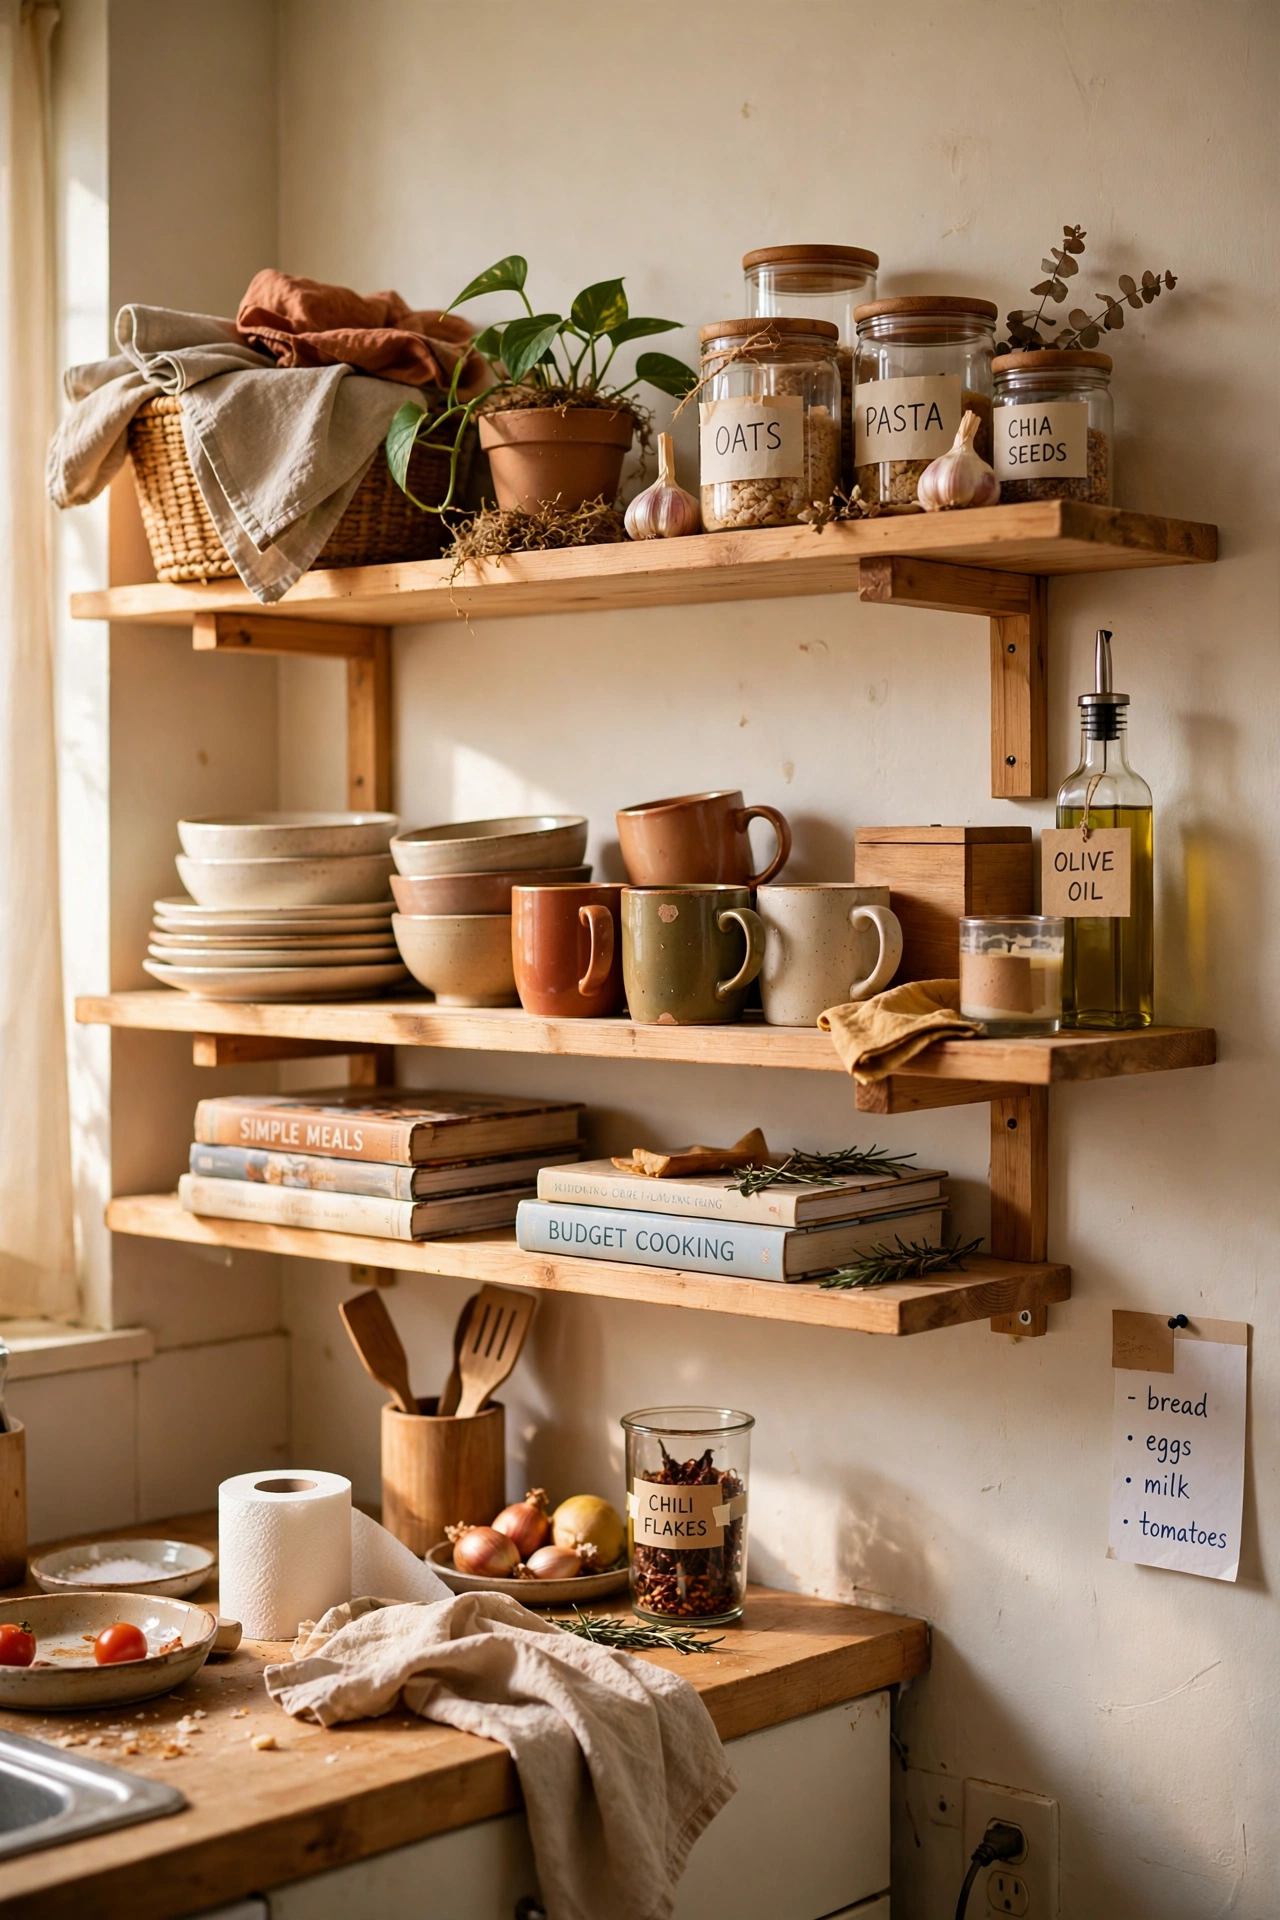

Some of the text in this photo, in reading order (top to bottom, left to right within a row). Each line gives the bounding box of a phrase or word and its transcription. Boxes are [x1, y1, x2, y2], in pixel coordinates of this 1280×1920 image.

[865, 402, 944, 437] PASTA
[1008, 416, 1052, 439] CHIA
[715, 421, 782, 456] OATS
[1008, 442, 1067, 466] SEEDS
[1054, 851, 1115, 872] OLIVE
[1068, 881, 1103, 902] OIL
[240, 1117, 300, 1145] SIMPLE
[306, 1125, 363, 1152] MEALS
[548, 1219, 628, 1249] BUDGET
[635, 1230, 735, 1262] COOKING
[1147, 1385, 1208, 1418] bread
[1146, 1434, 1191, 1465] eggs
[1144, 1472, 1190, 1500] milk
[649, 1494, 693, 1514] CHILI
[644, 1517, 707, 1537] FLAKES
[1139, 1511, 1227, 1549] tomatoes
